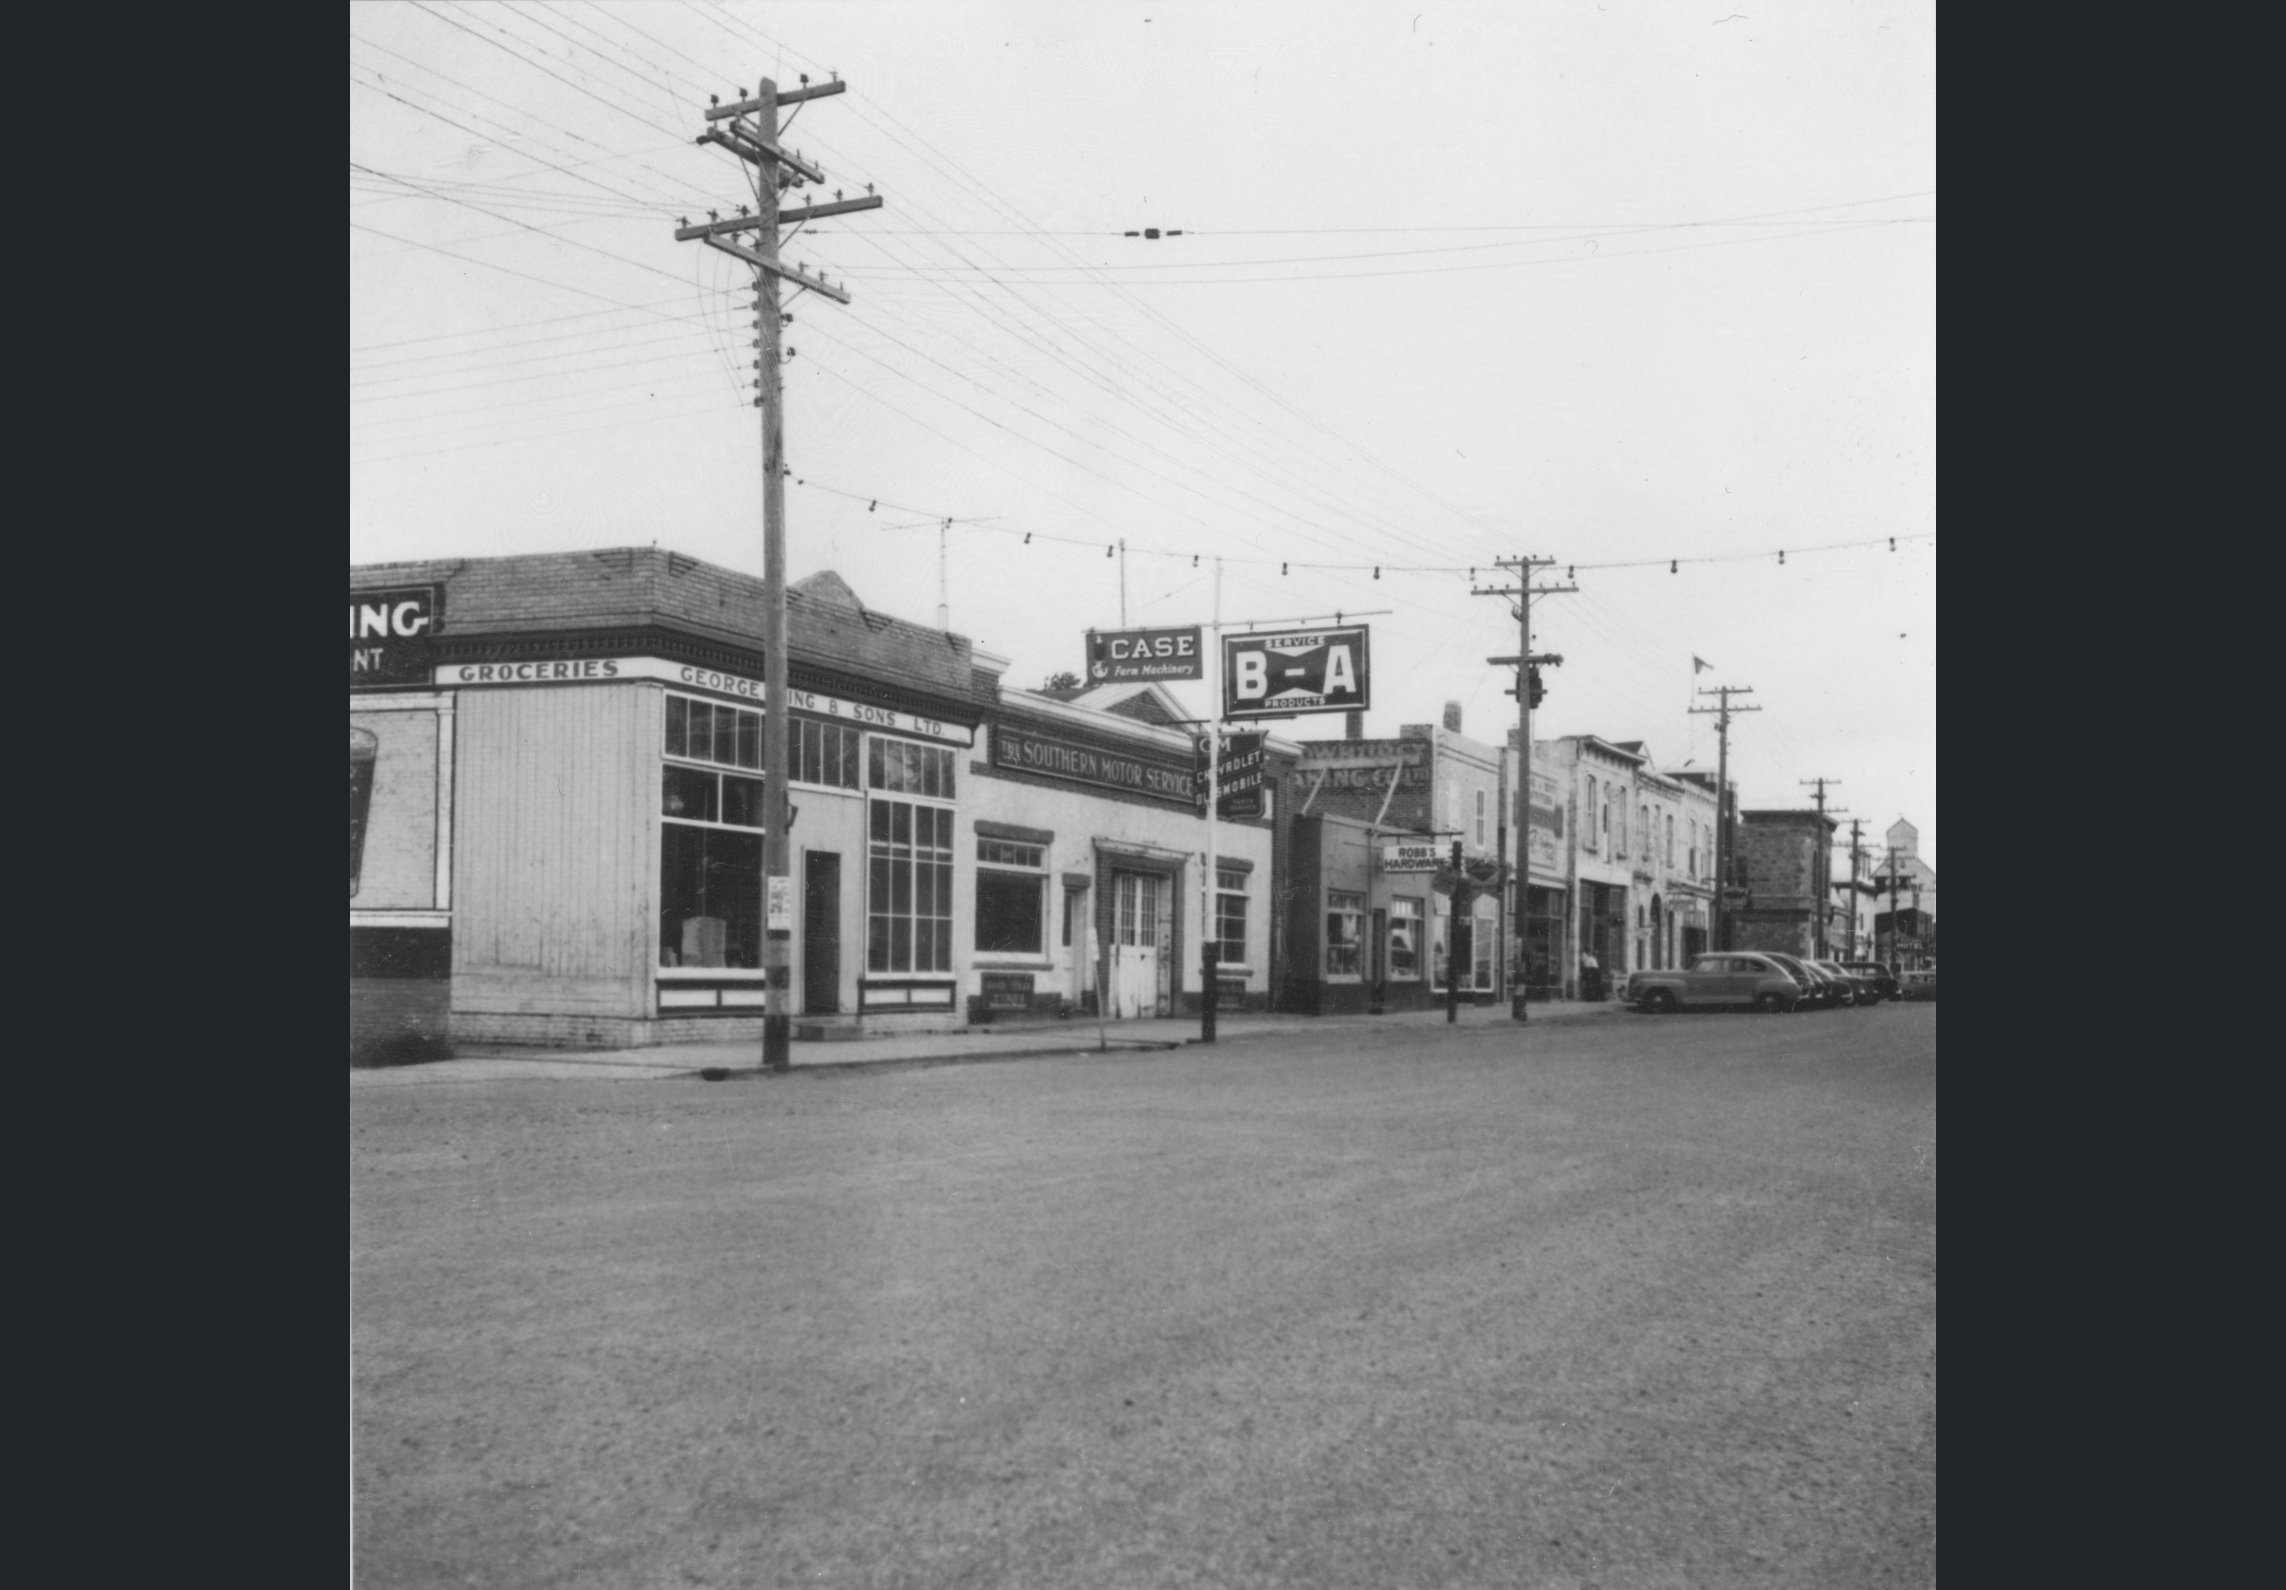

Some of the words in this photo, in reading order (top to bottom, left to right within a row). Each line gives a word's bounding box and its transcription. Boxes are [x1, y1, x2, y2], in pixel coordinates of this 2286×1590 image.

[1111, 635, 1194, 659] CASE
[1264, 636, 1326, 648] SERVICE
[459, 659, 619, 682] GROCERIES
[1114, 665, 1139, 677] Farm
[1141, 663, 1194, 677] Machinery
[680, 666, 760, 697] GEORGE
[789, 690, 815, 709] ING
[854, 703, 895, 726] SONS
[1264, 698, 1326, 708] PRODUCTS
[1024, 740, 1097, 777] SOUTHERN
[1101, 757, 1142, 786] MOTOR
[1147, 767, 1194, 797] SERVICE
[1197, 750, 1261, 784] CHVROLET
[1196, 771, 1262, 806] OLSMOBILE
[1399, 847, 1436, 858] ROBB'S
